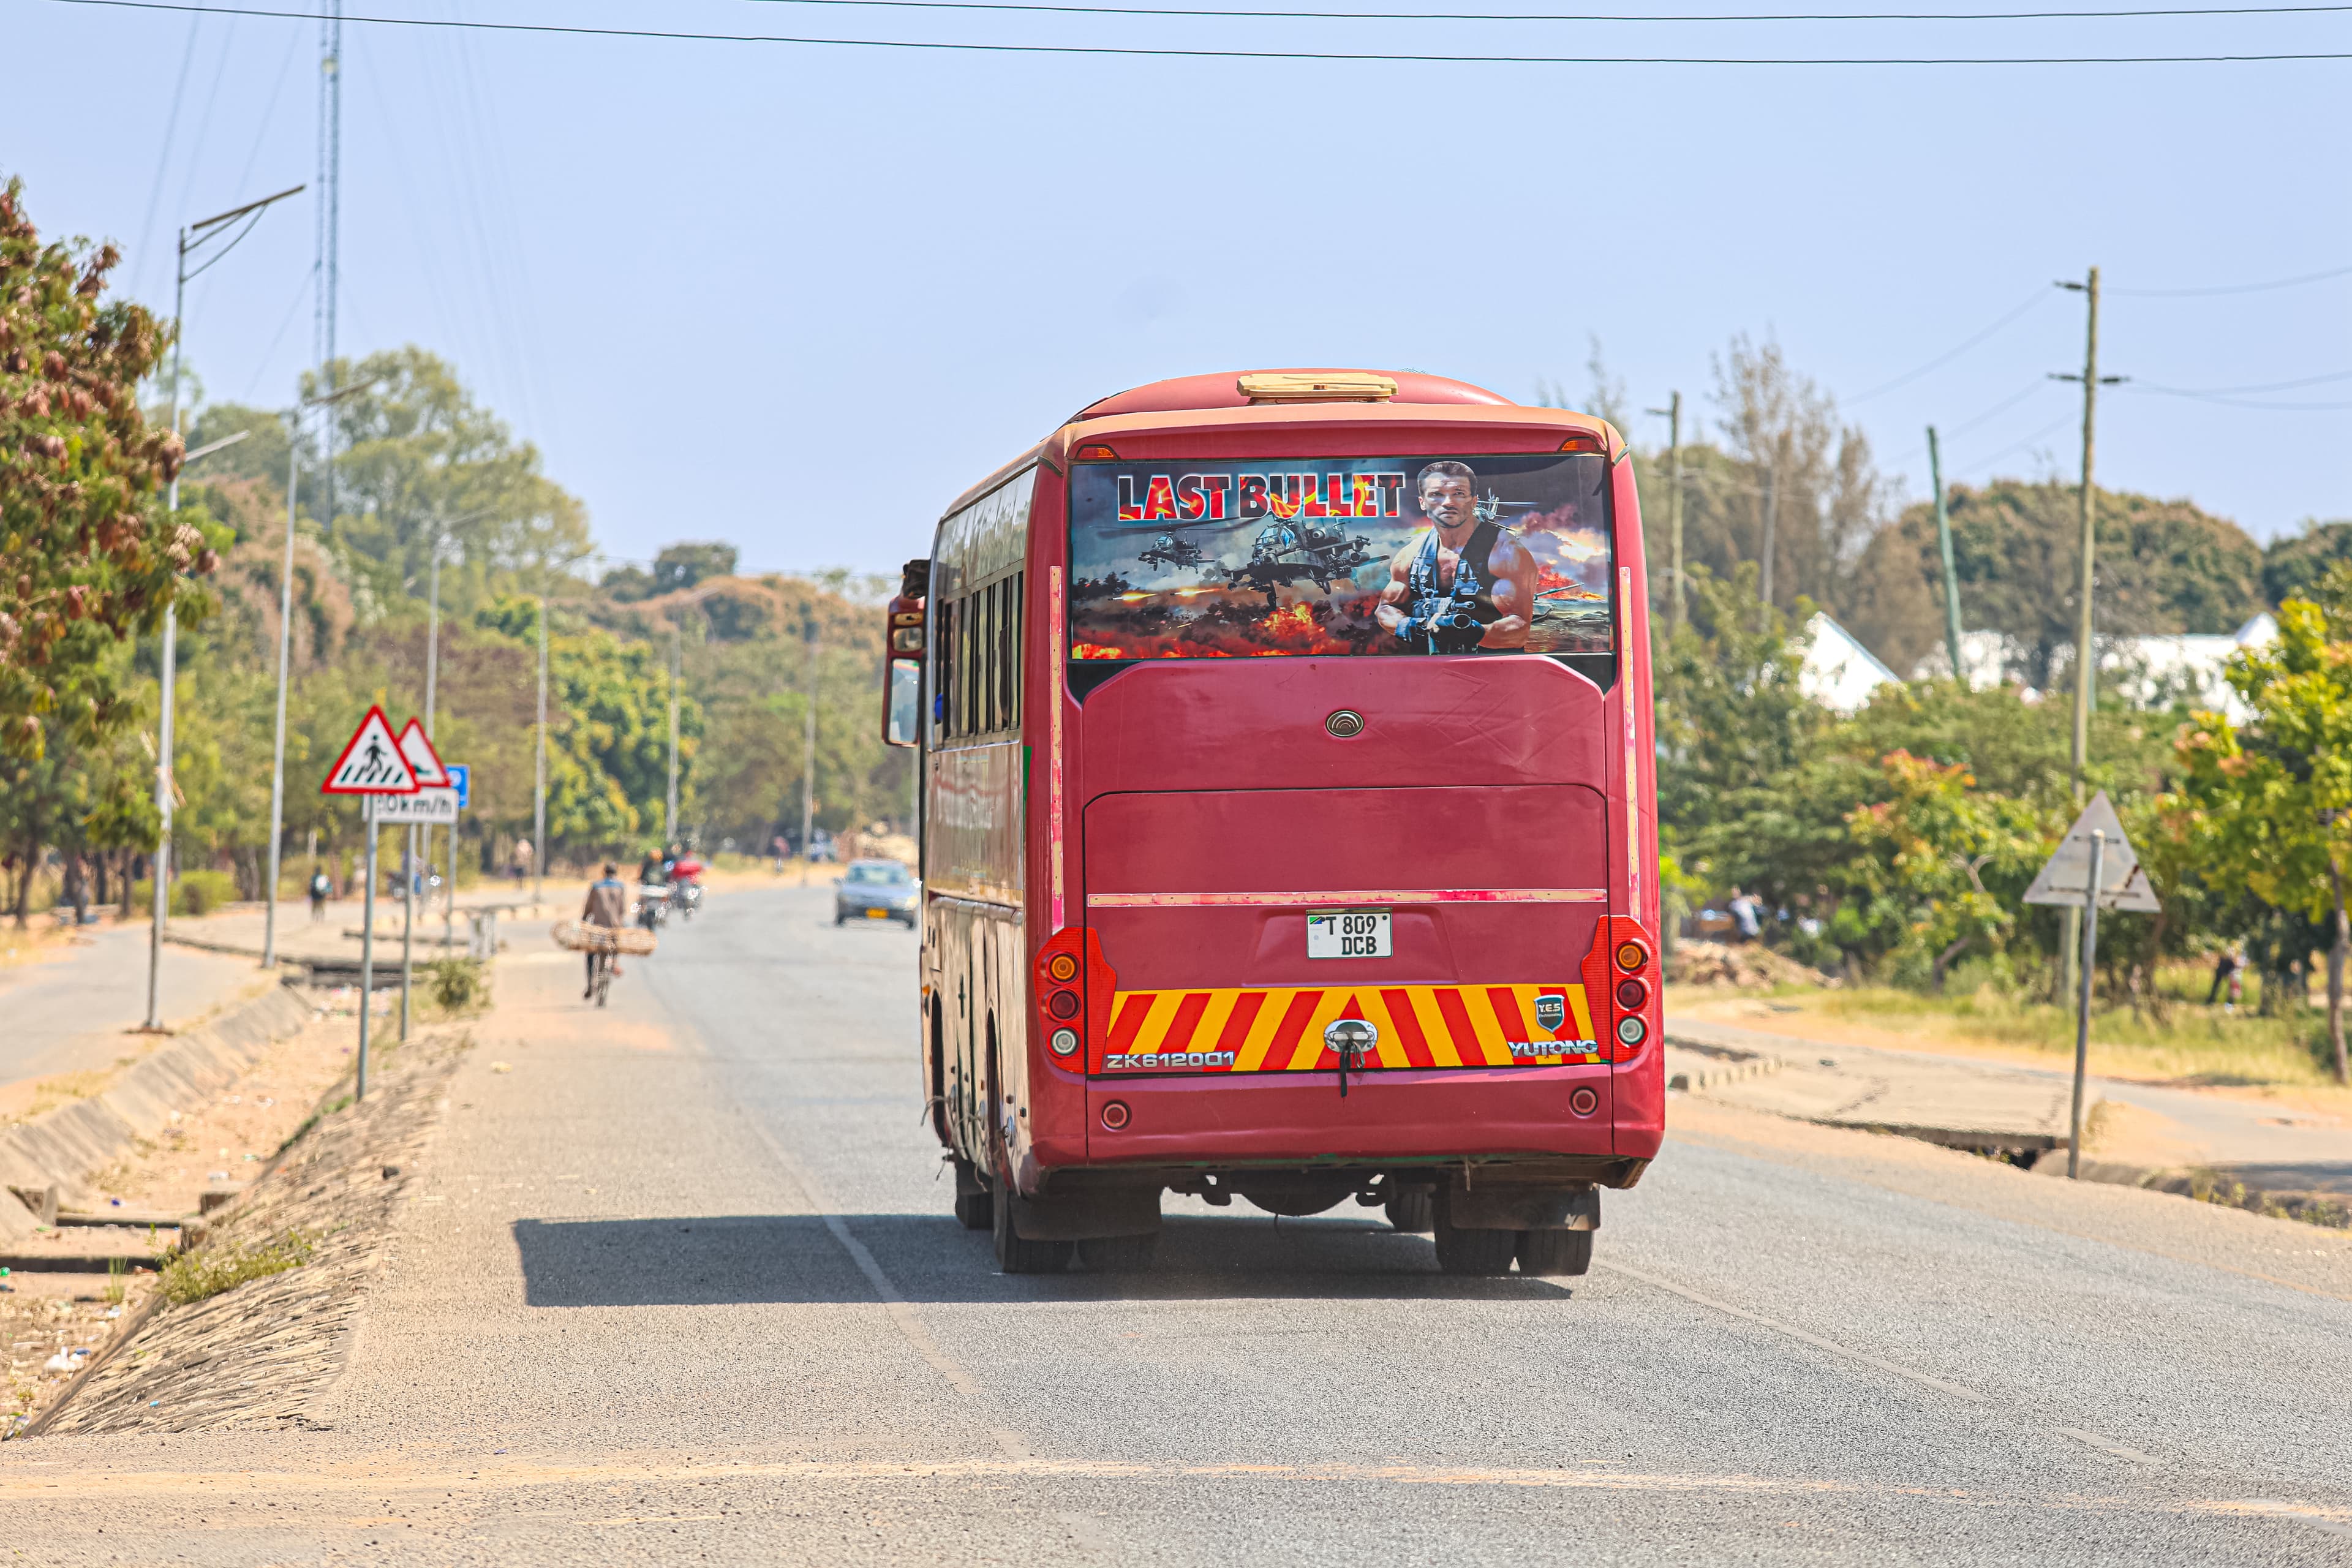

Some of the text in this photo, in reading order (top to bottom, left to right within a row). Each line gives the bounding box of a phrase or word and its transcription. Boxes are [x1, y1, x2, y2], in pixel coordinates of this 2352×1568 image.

[1118, 473, 1406, 521] LAST BULLET
[1325, 915, 1376, 935] T 809
[1341, 936, 1377, 955] DCB
[1507, 1039, 1598, 1057] YUTONG
